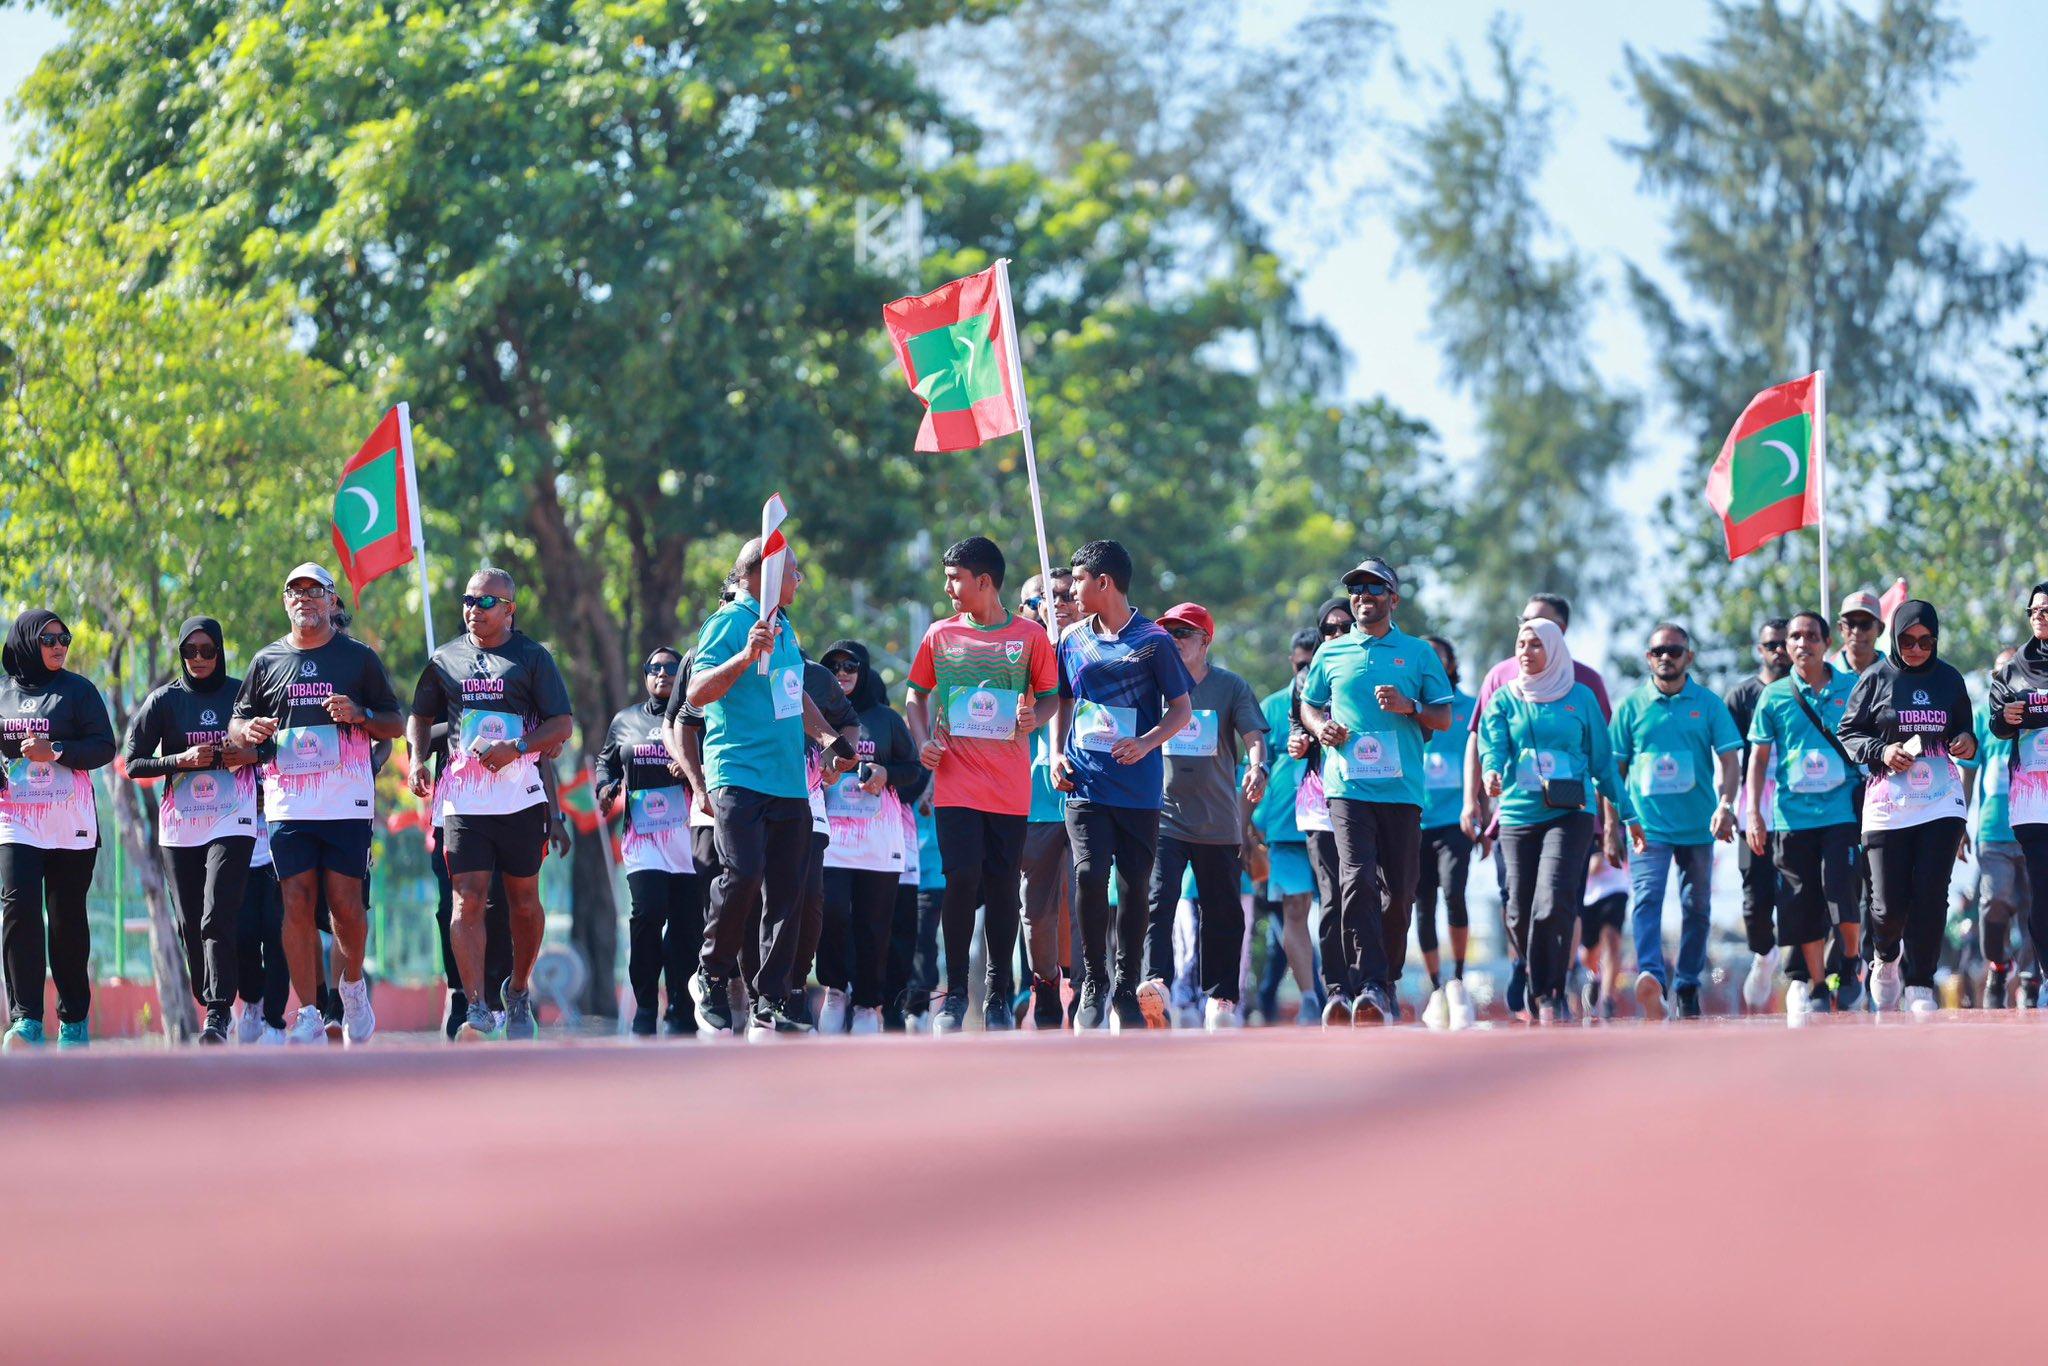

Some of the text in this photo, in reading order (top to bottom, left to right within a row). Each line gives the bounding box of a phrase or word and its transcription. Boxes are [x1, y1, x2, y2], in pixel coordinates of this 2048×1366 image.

[286, 682, 333, 698] TOBACCO
[460, 678, 504, 692] TOBACCO
[287, 699, 299, 707] FREE
[2028, 706, 2043, 714] FREE
[1897, 710, 1947, 724] TOBACCO
[3, 718, 49, 731] TOBACCO
[1898, 724, 1913, 732] FREE
